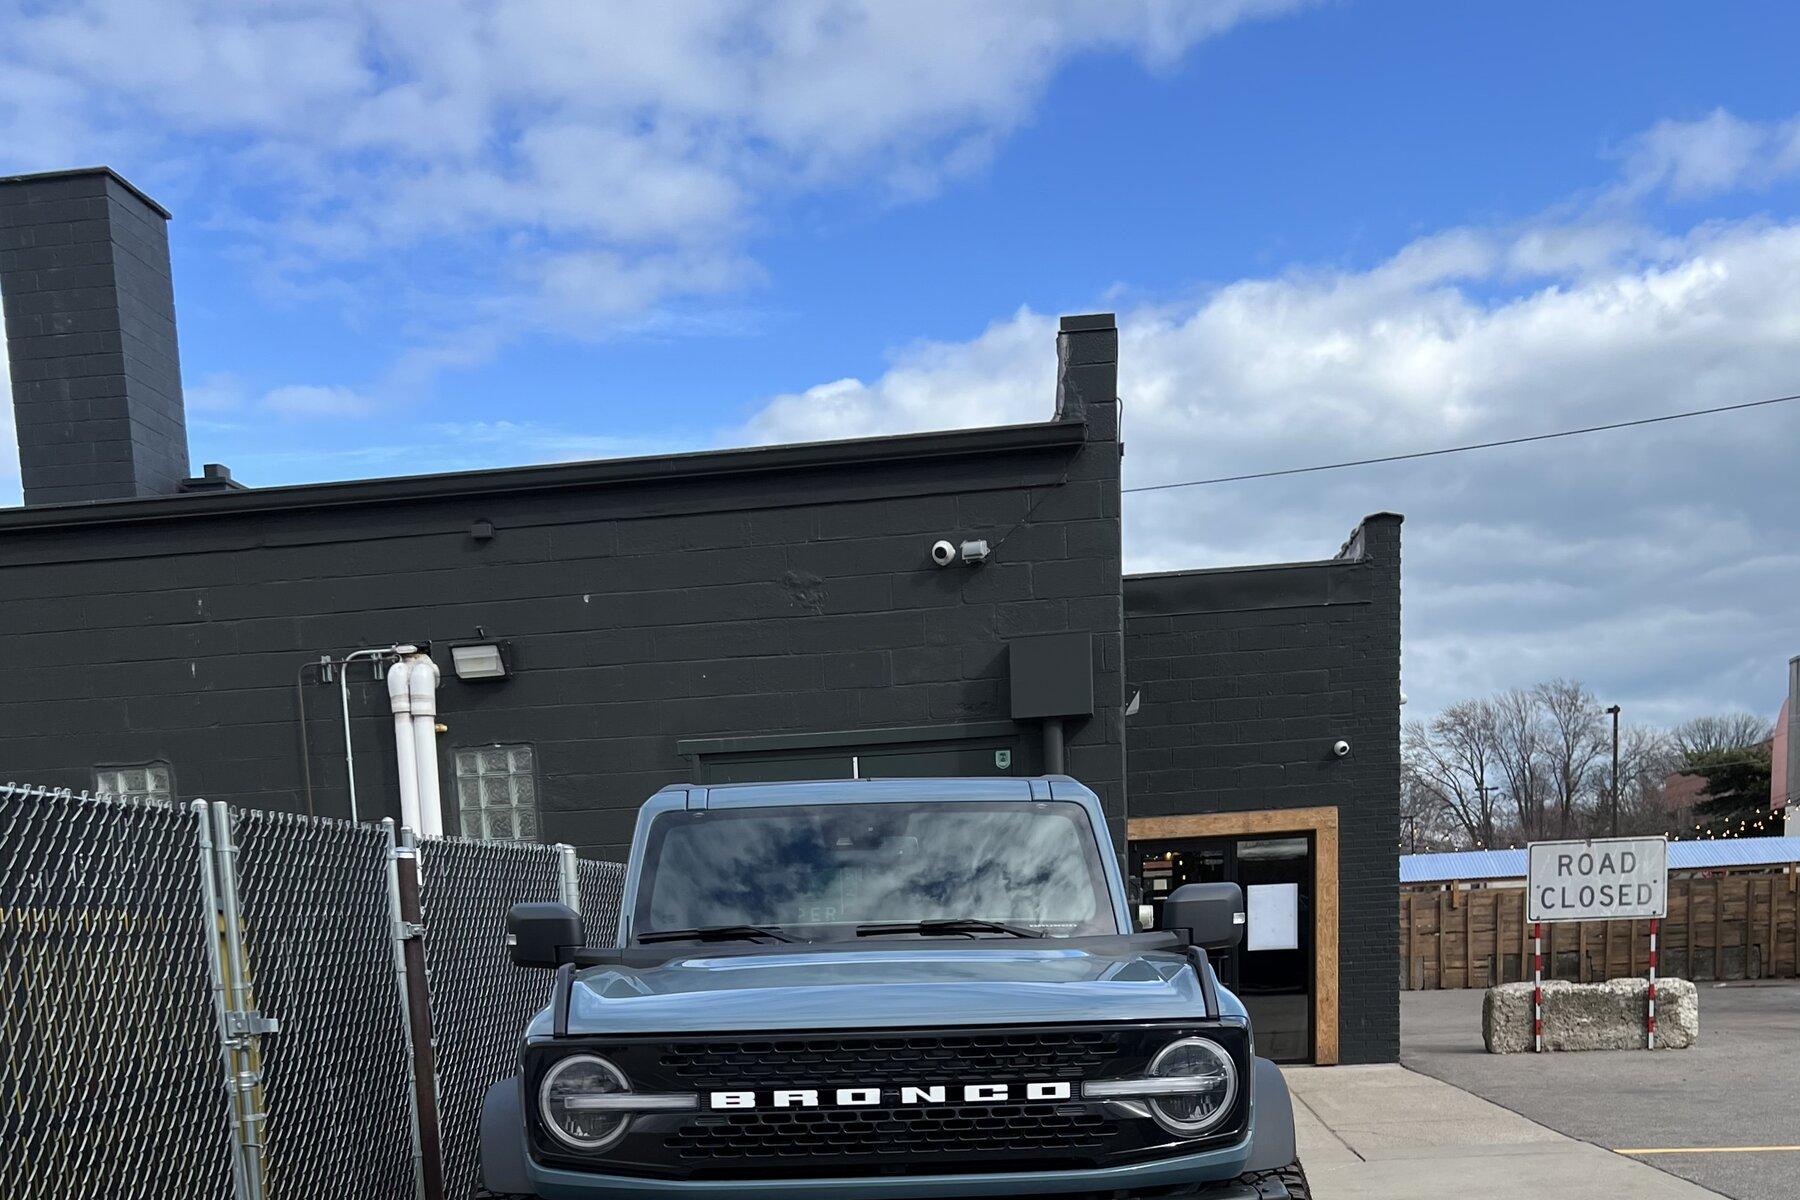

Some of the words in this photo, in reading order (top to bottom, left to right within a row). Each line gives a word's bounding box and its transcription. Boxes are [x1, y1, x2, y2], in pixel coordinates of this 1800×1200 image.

[1557, 851, 1637, 877] ROAD
[1540, 883, 1653, 910] CLOSED
[710, 1081, 1072, 1109] BRONCO
